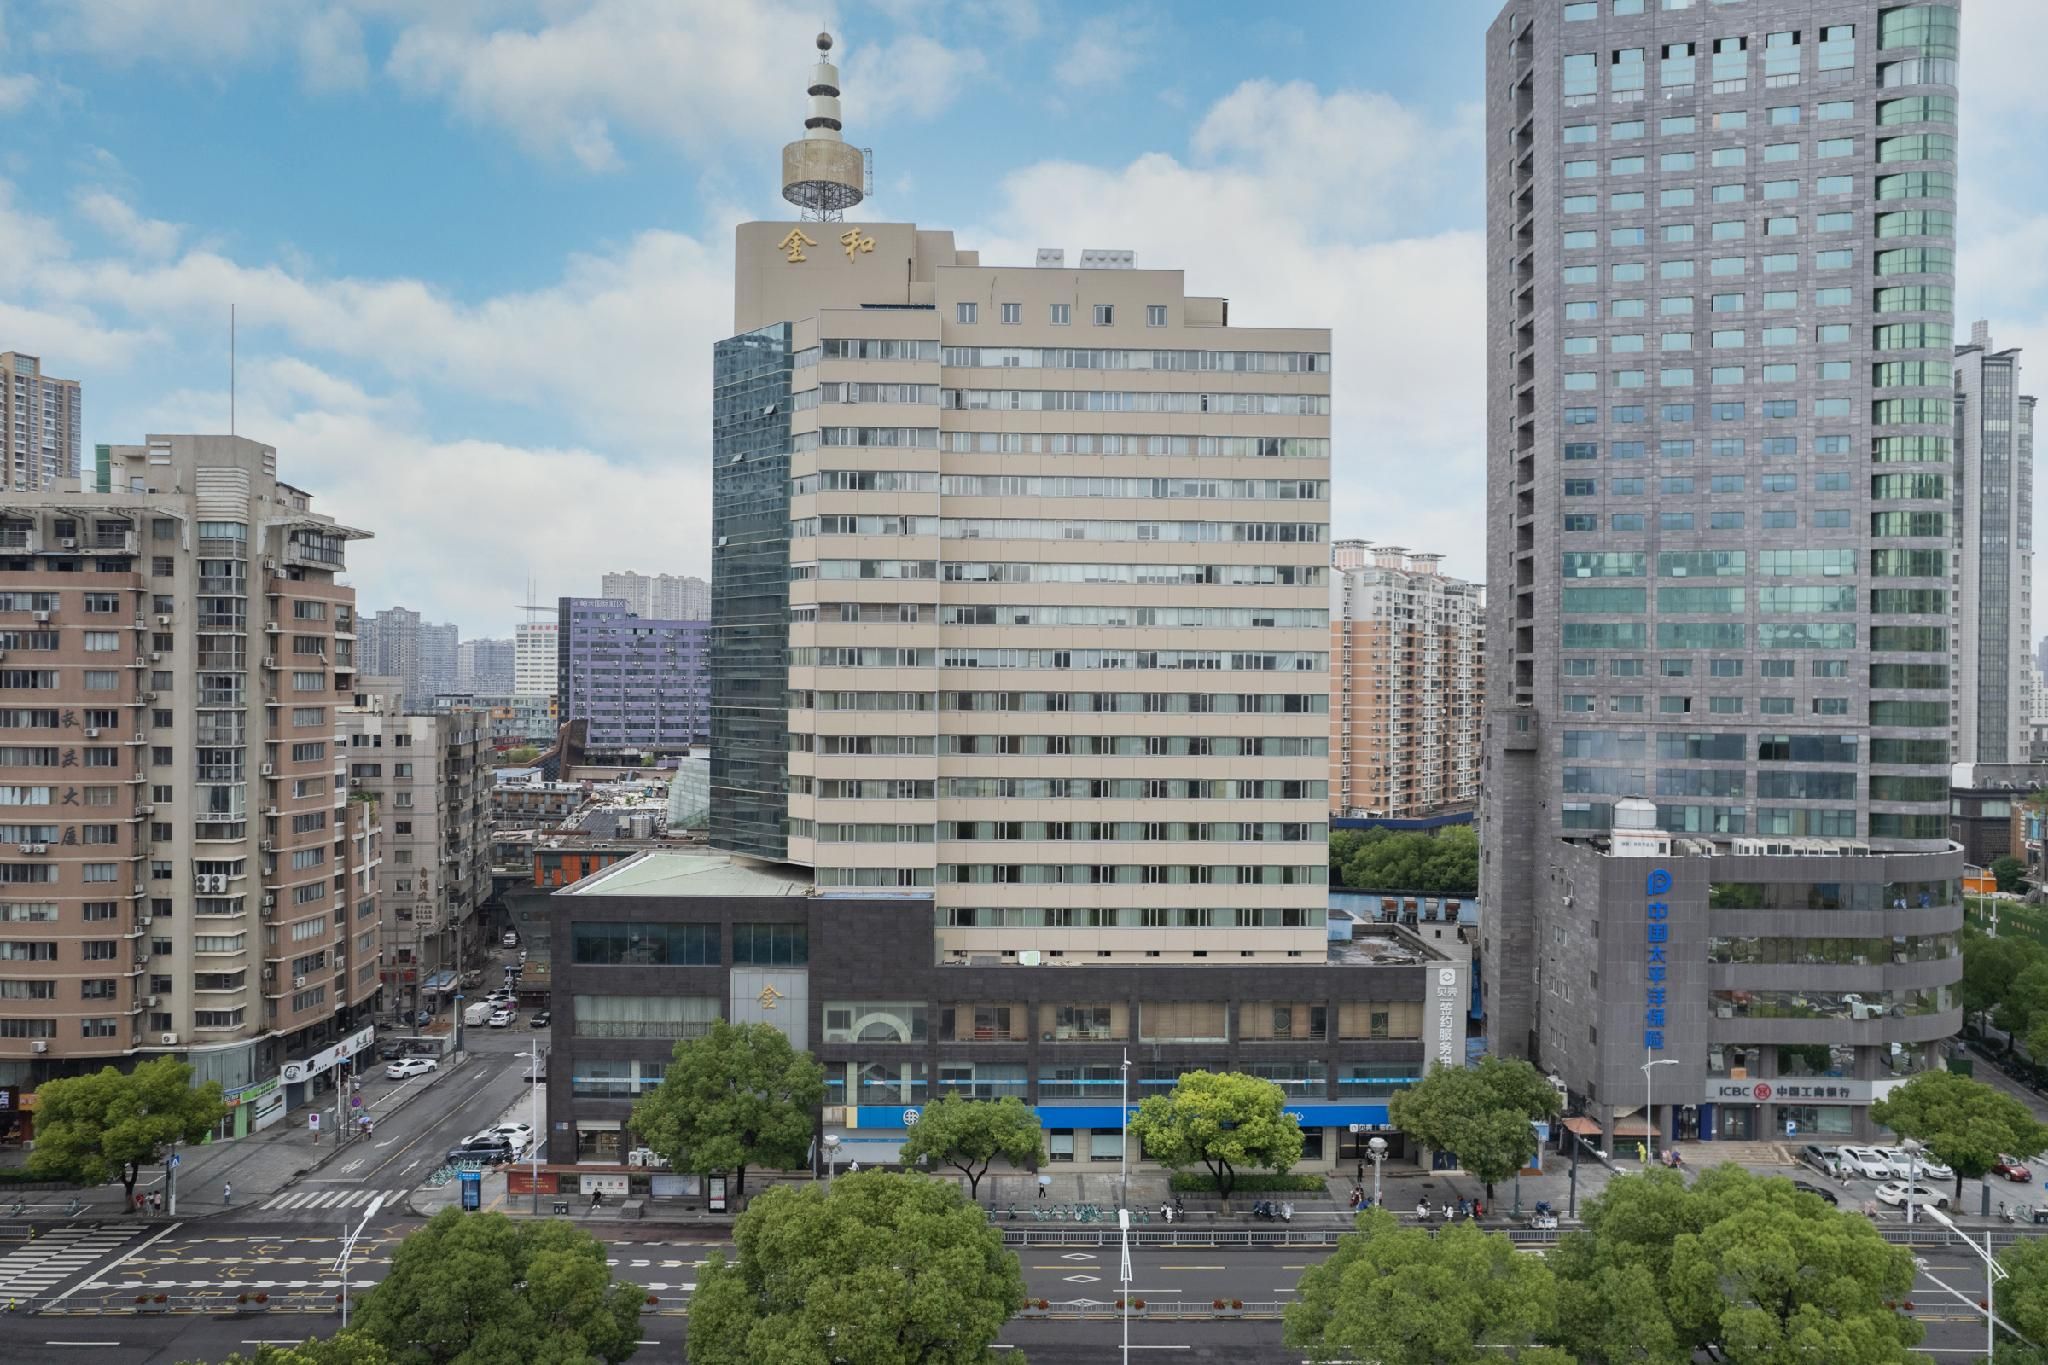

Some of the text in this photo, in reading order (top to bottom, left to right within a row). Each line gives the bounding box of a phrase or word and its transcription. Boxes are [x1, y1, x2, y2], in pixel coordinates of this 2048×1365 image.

[777, 226, 876, 264] 金和
[1644, 902, 1668, 1049] 中国太平洋保险
[1719, 1086, 1750, 1097] ICBC
[1776, 1085, 1851, 1098] 中国工商银行
